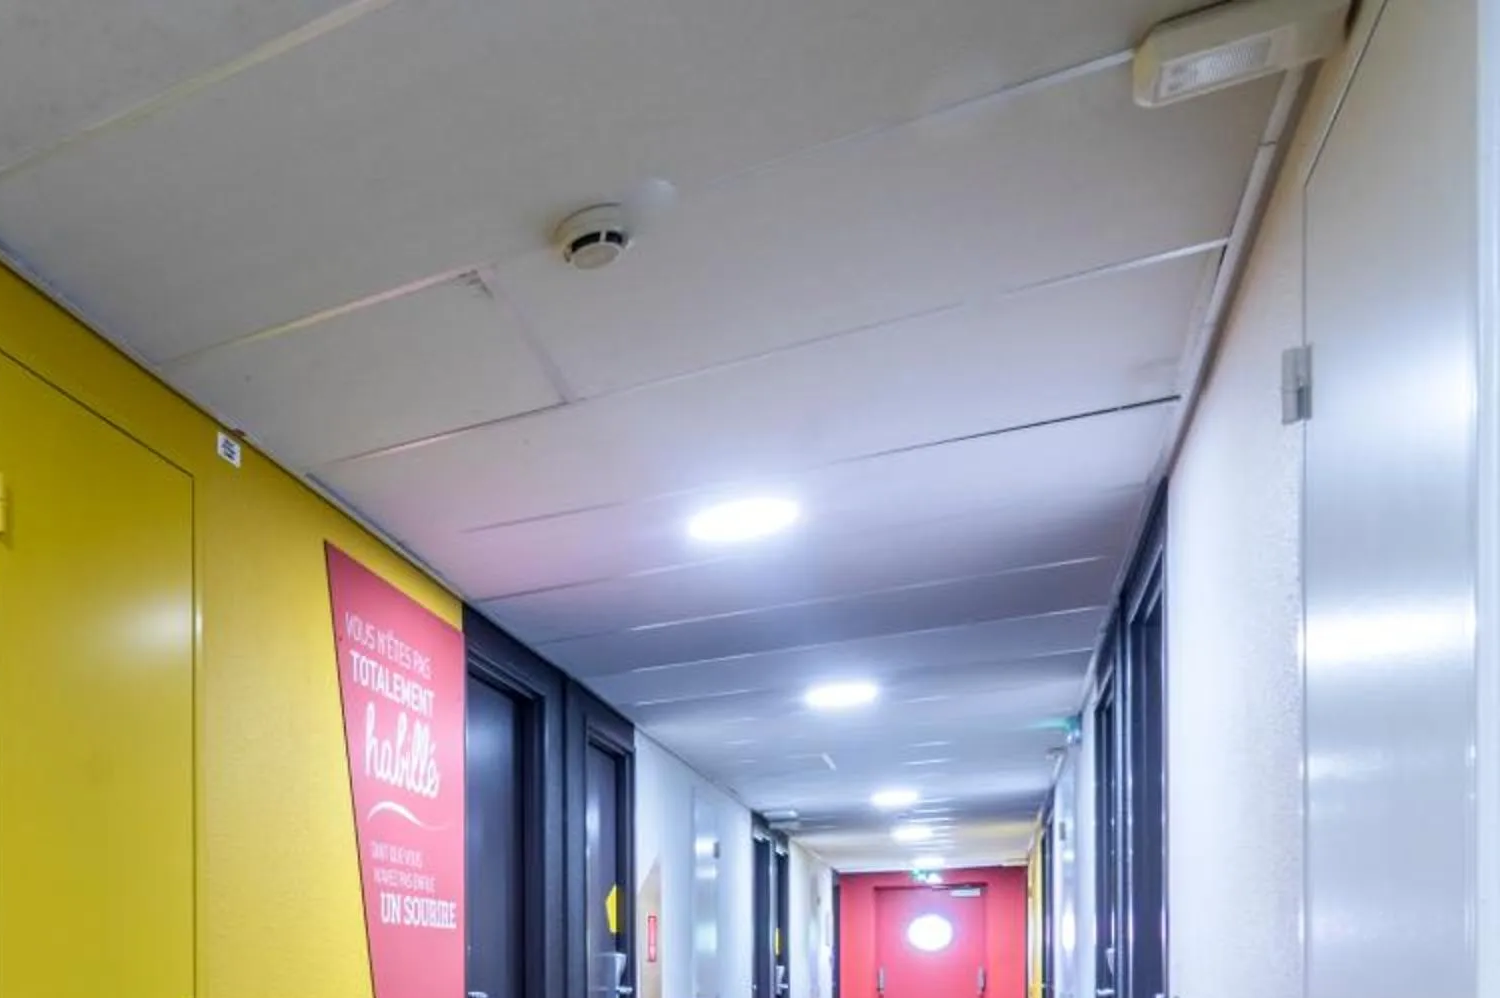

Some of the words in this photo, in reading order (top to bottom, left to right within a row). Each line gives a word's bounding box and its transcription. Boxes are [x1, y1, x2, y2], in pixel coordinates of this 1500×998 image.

[344, 611, 376, 650] VOUS
[412, 649, 432, 680] PAS
[349, 649, 435, 718] TOTALEMENT
[380, 891, 401, 924] UN
[403, 895, 457, 929] SOURIRE
